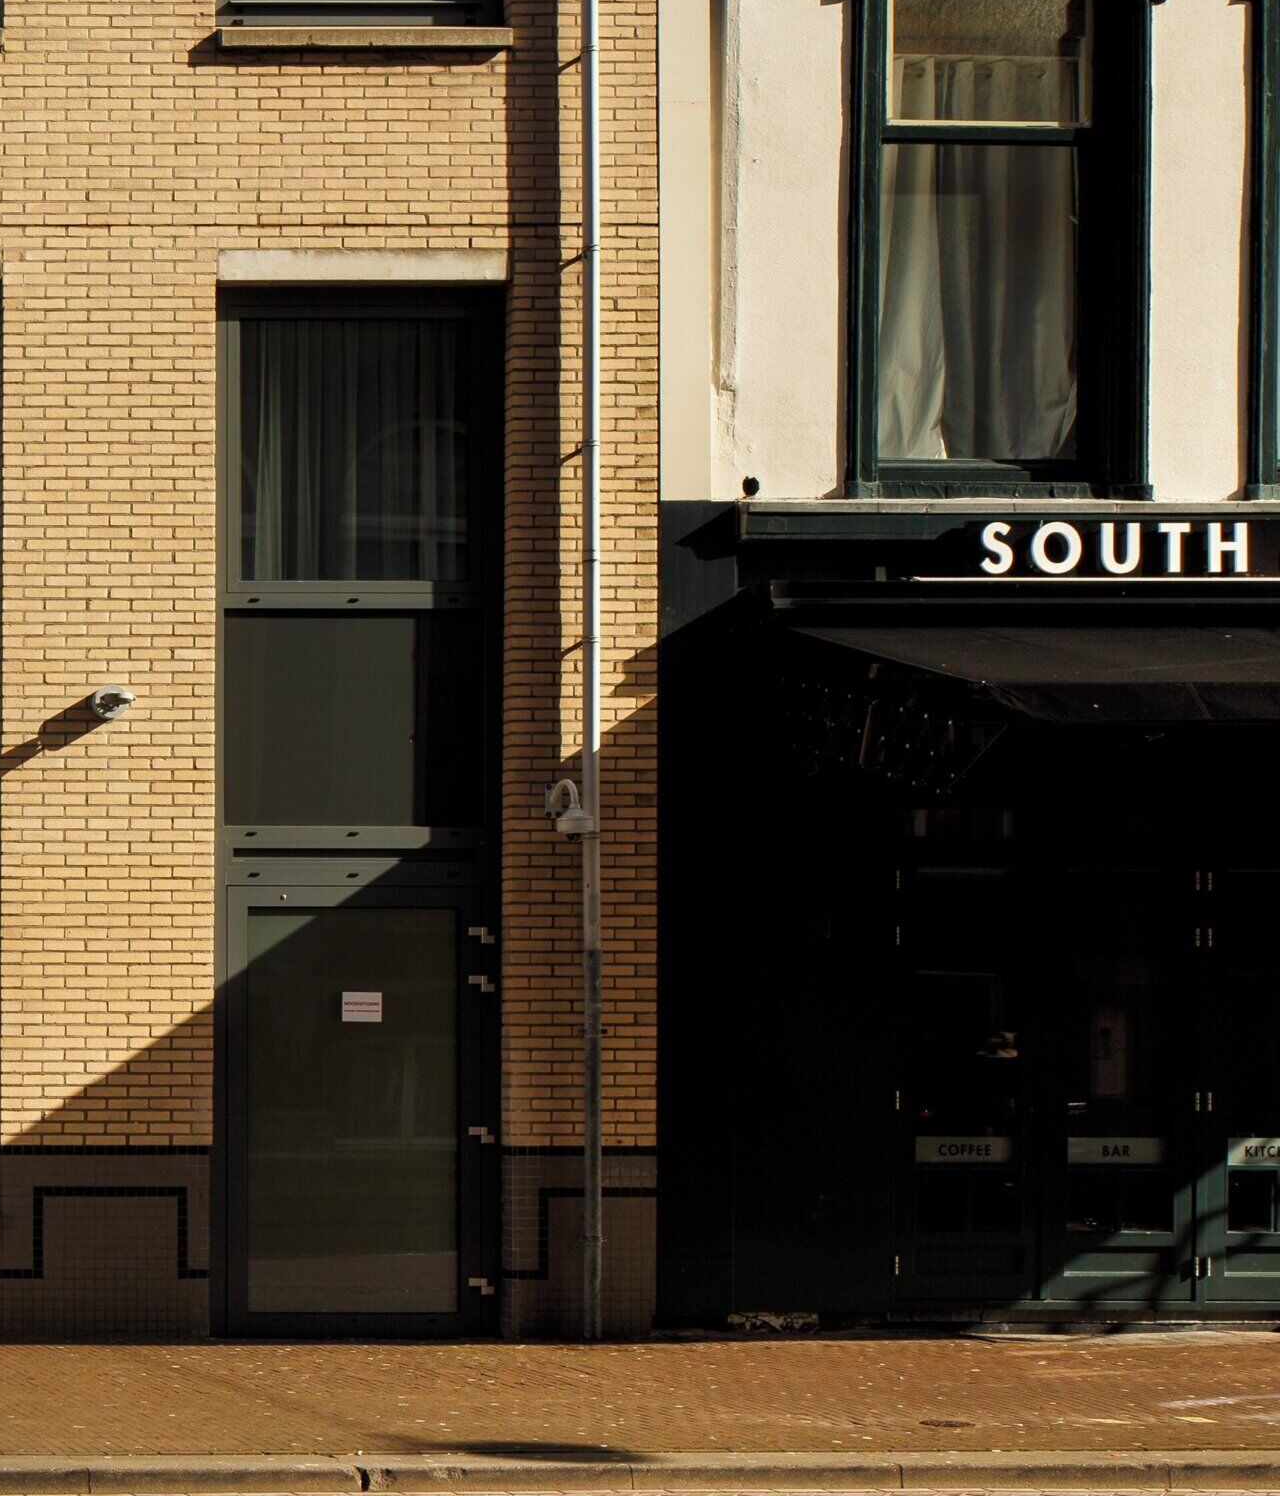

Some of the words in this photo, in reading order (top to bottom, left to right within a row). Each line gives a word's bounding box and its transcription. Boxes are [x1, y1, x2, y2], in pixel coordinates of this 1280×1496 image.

[980, 521, 1249, 574] SOUTH
[938, 1144, 992, 1157] COFFEE
[1101, 1145, 1130, 1157] BAR
[1244, 1145, 1280, 1158] KITC
